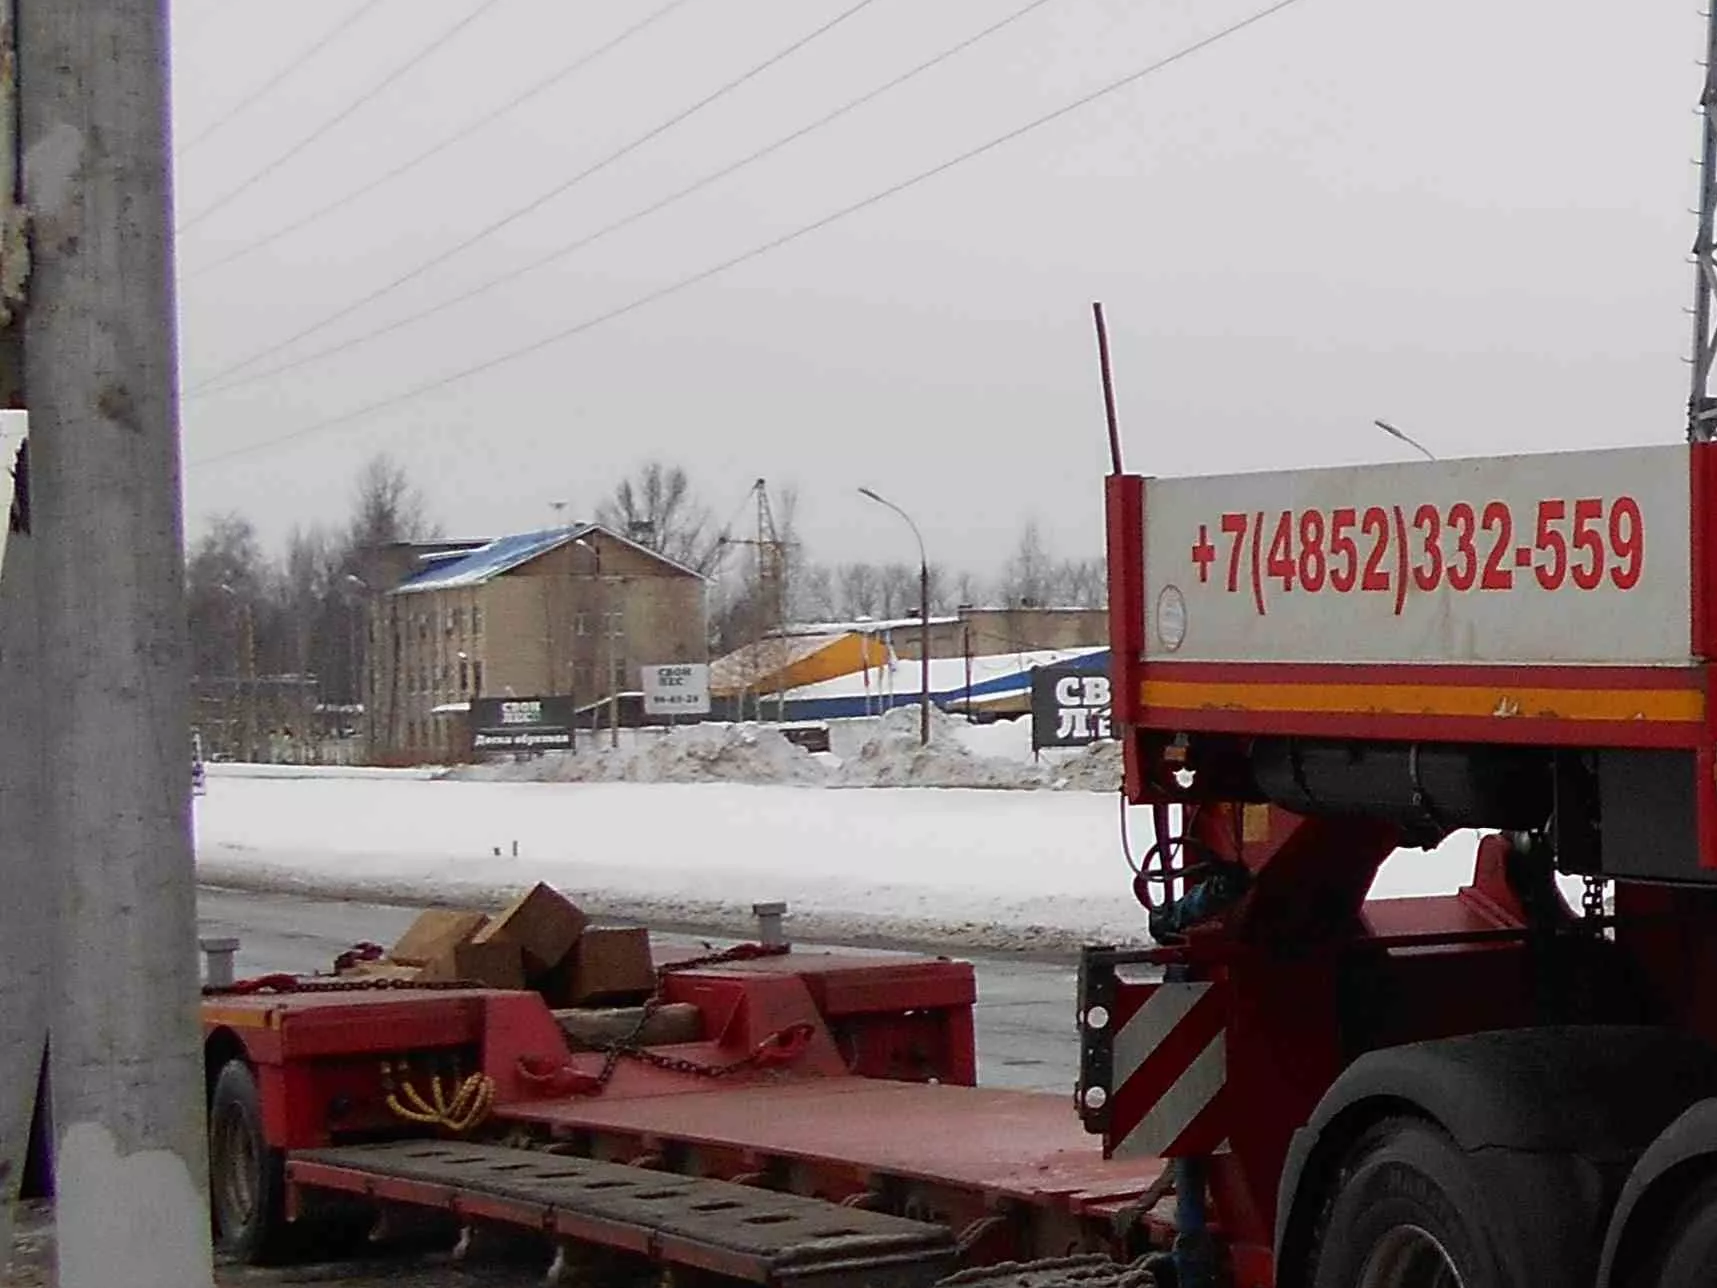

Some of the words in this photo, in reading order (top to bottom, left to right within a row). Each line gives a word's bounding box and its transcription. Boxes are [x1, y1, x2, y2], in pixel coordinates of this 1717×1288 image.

[1191, 497, 1643, 615] +7(4852)332-559
[1056, 677, 1111, 706] СВ
[1056, 708, 1111, 738] ЛЕ
